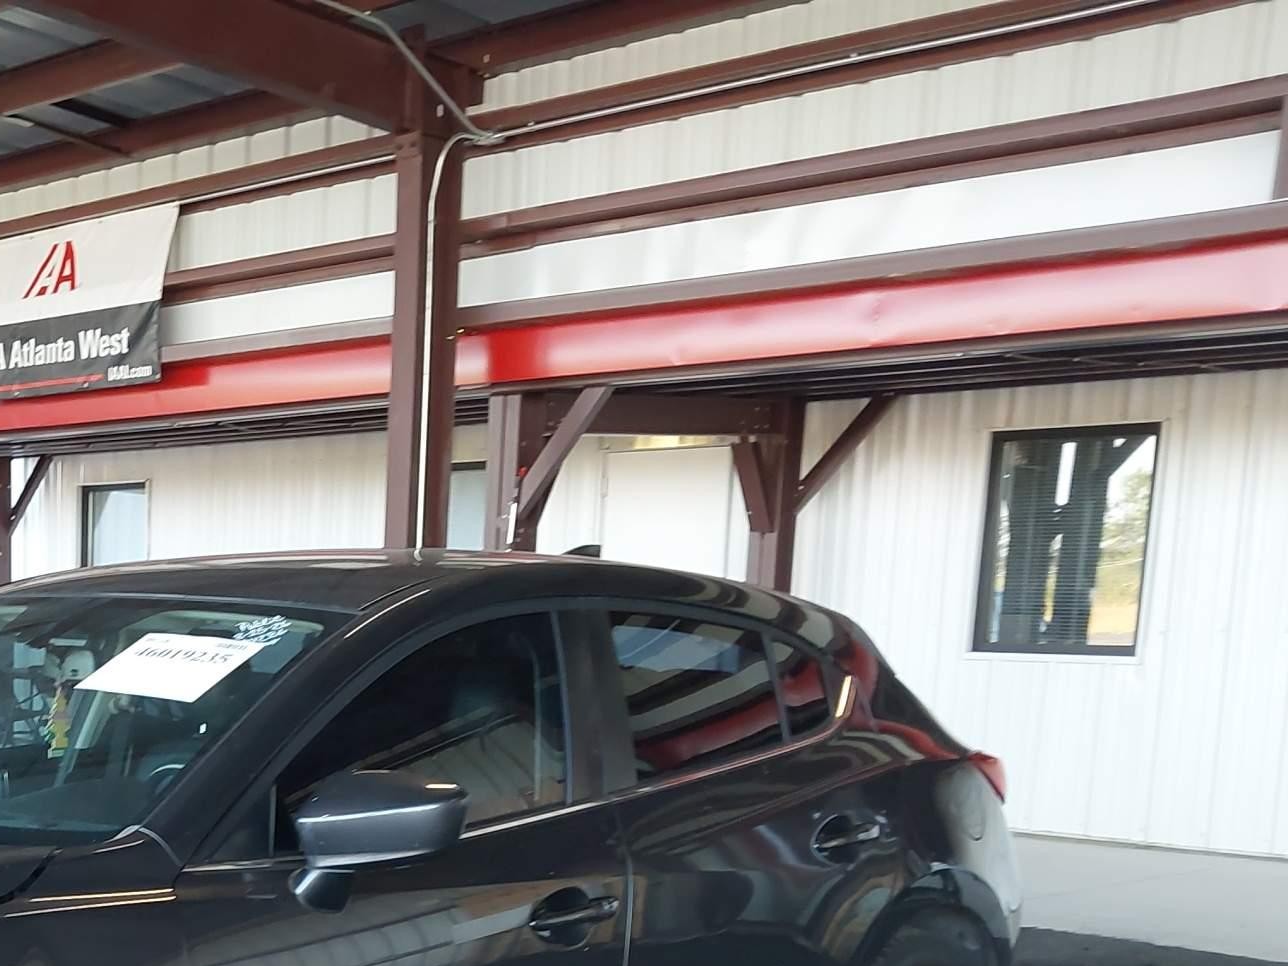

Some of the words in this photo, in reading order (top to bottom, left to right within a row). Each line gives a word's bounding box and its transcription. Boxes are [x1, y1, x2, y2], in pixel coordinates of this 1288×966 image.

[9, 337, 75, 369] Atlanta
[78, 327, 130, 360] West
[135, 646, 233, 663] 46019235
